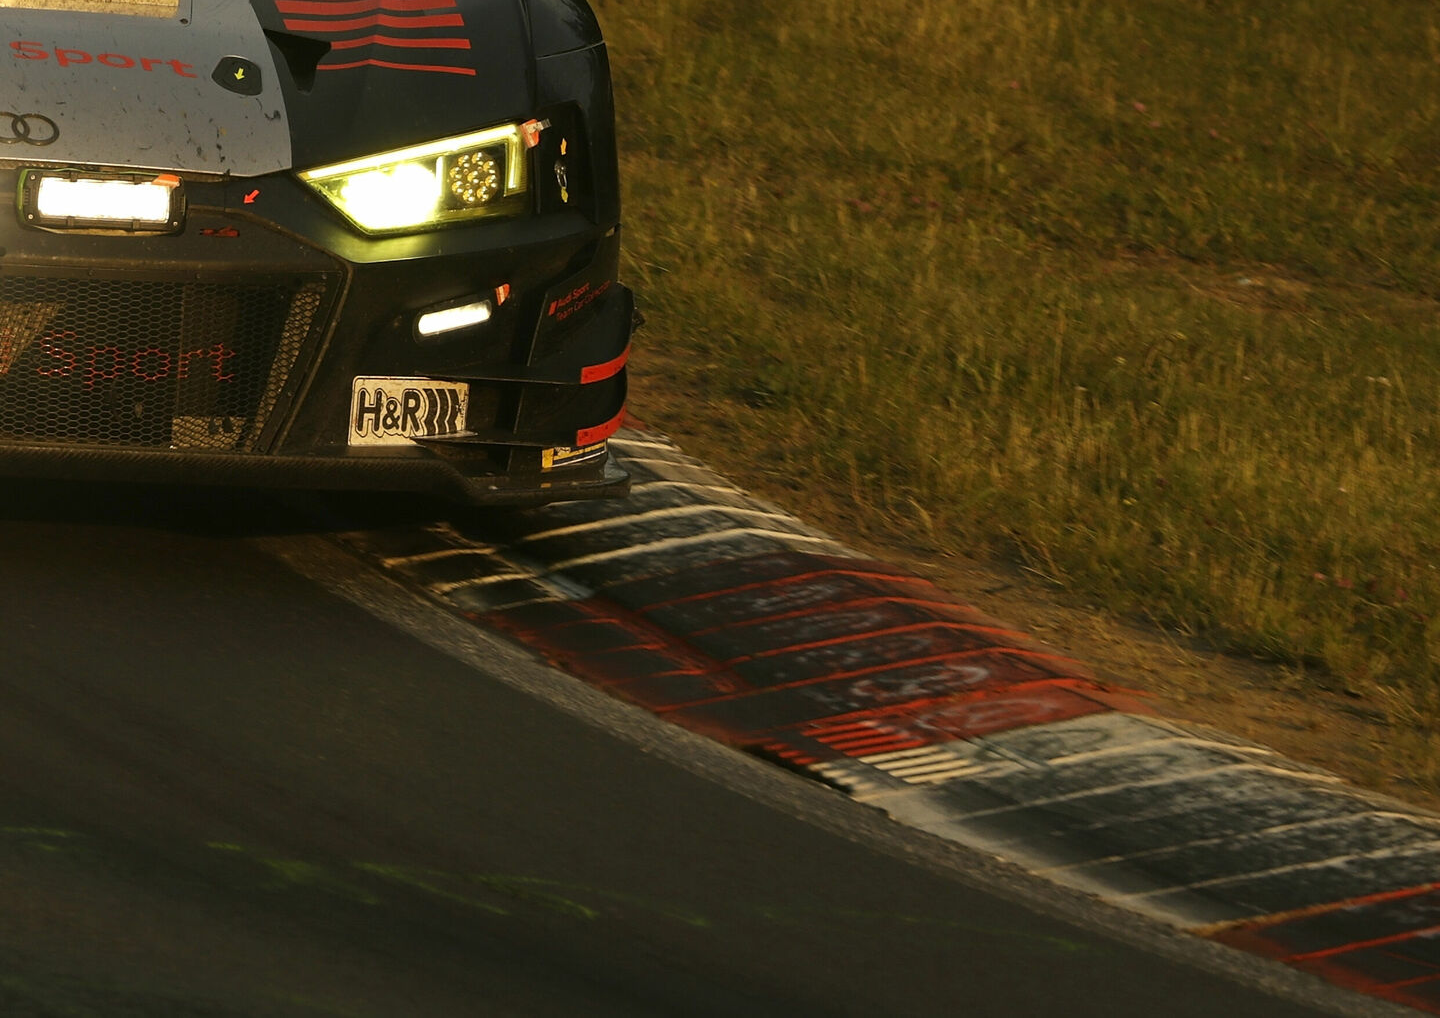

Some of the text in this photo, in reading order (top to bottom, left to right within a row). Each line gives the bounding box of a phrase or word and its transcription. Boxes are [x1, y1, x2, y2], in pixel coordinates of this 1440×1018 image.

[9, 41, 198, 78] Sport
[37, 331, 236, 391] Sport
[356, 387, 426, 438] H&R
